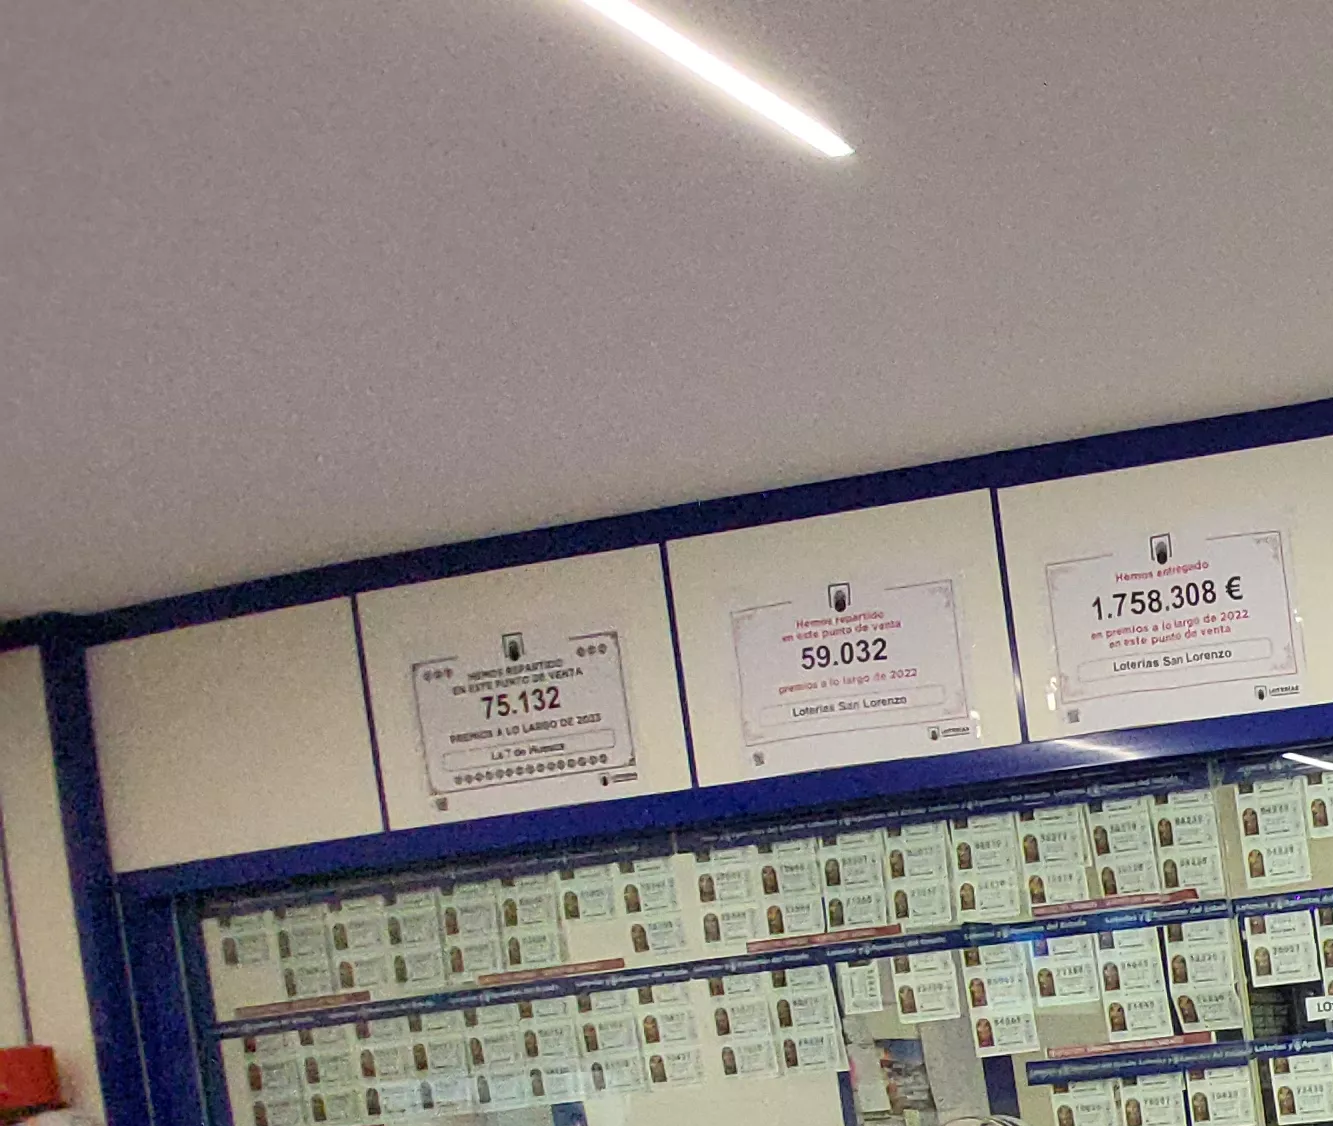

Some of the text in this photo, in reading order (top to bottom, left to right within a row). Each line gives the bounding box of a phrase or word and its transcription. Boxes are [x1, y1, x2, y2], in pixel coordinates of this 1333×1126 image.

[1115, 560, 1210, 583] Hemos entregado
[1091, 576, 1244, 621] 1.758.308 €
[796, 611, 885, 629] Hemos repartido
[1105, 623, 1149, 640] premios
[1152, 623, 1159, 632] a
[1161, 619, 1172, 631] lo
[1174, 615, 1200, 630] largo
[1203, 612, 1217, 624] de
[1220, 609, 1250, 622] 2022
[1123, 636, 1147, 647] este
[1151, 632, 1181, 646] punto
[1184, 628, 1197, 639] de
[1200, 624, 1232, 636] venta
[801, 637, 888, 670] 59.032
[1162, 656, 1184, 667] San
[1186, 649, 1232, 663] Lorenzo
[889, 667, 918, 680] 2022
[481, 686, 561, 720] 75.132
[863, 695, 908, 708] Lorenzo
